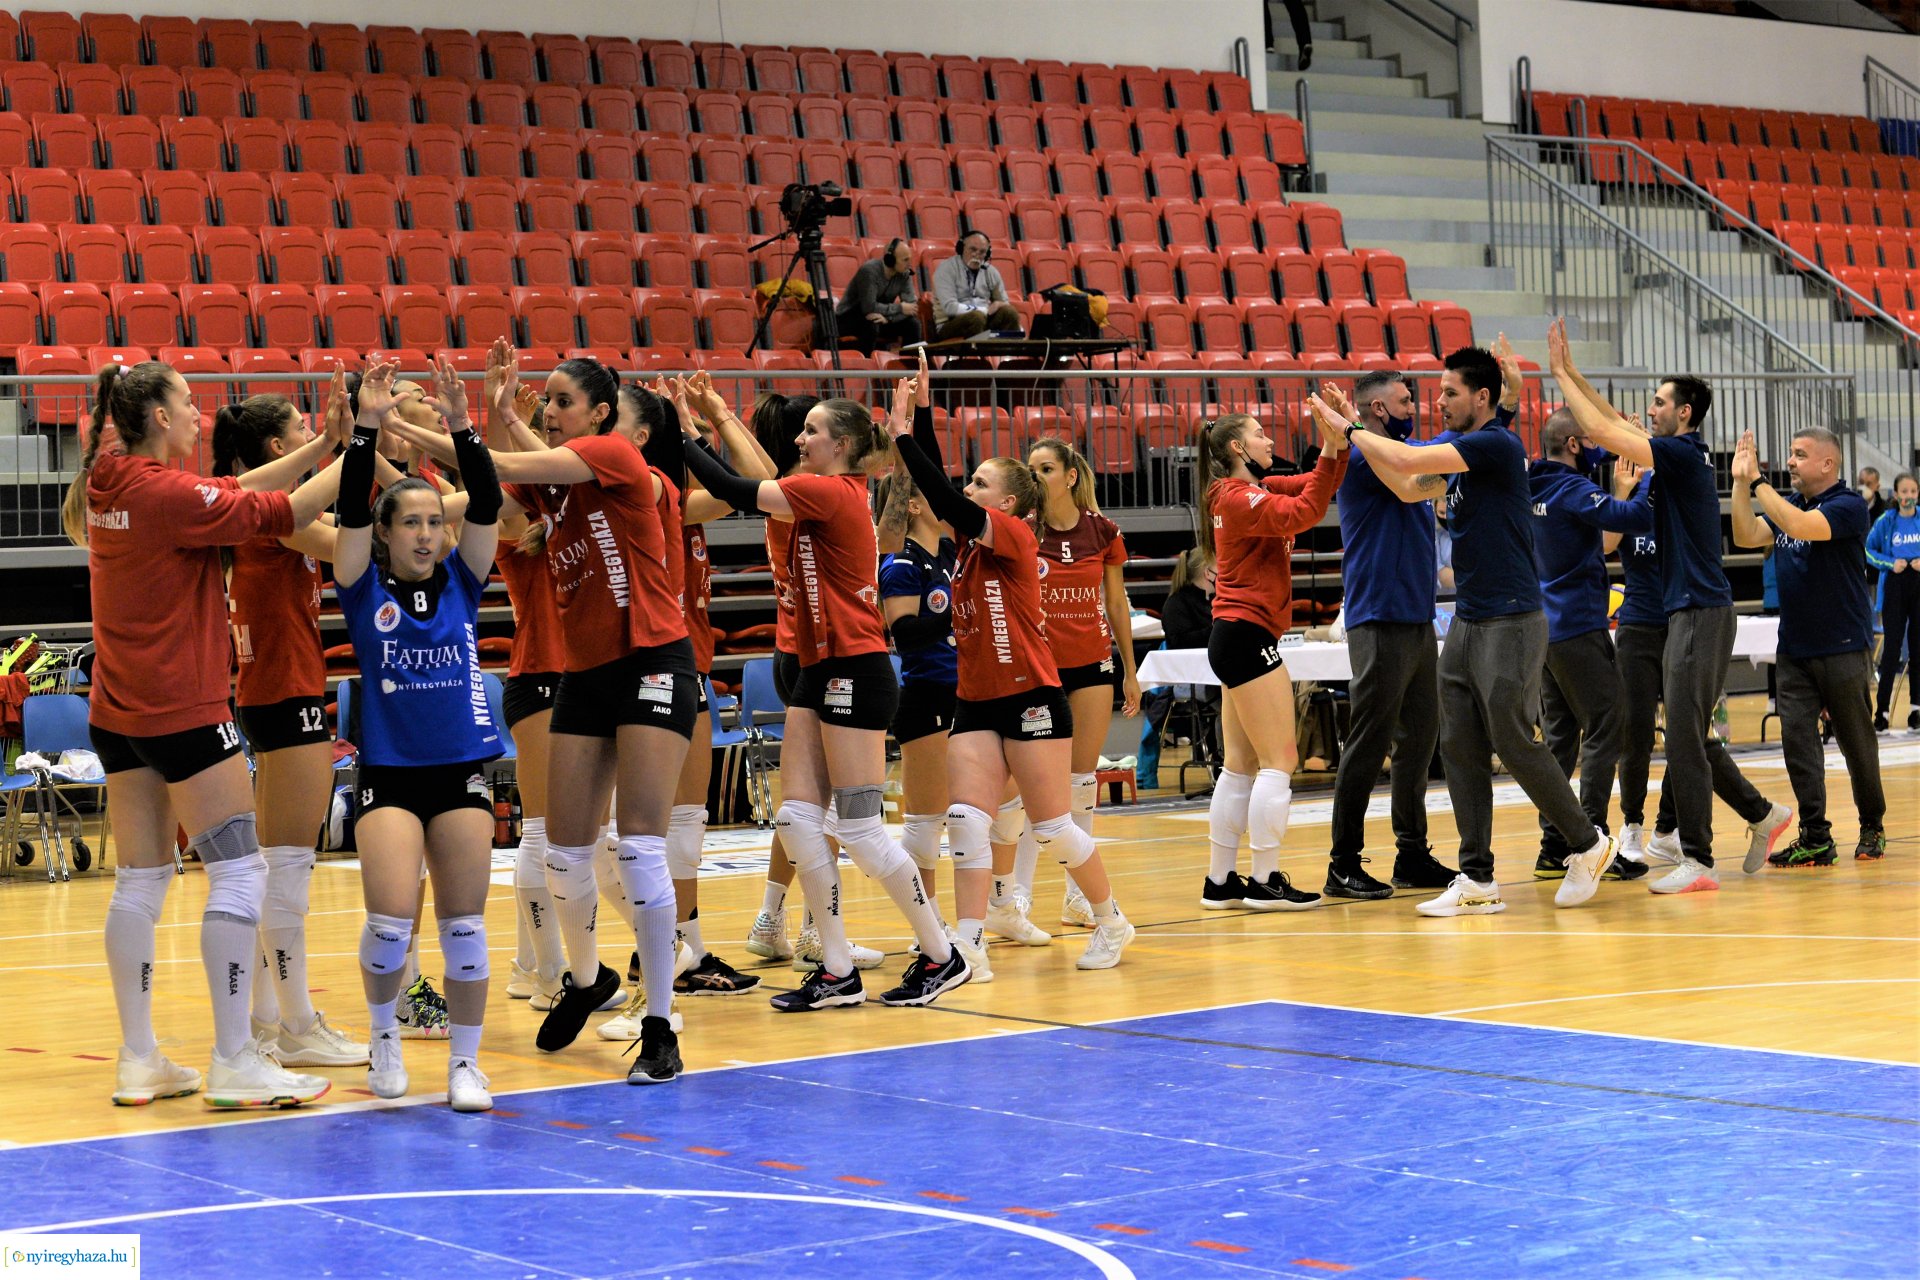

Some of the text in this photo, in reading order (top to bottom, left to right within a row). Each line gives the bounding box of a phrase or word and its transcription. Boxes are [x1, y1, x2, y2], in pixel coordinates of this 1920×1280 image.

[1061, 541, 1072, 559] 5
[1902, 533, 1920, 544] JAK
[413, 590, 428, 613] 8
[984, 580, 1013, 664] NYÍREGYHÁZA
[381, 638, 462, 666] FATUM
[1260, 646, 1279, 666] 15
[398, 679, 464, 691] NYÍREGYHÁZA
[464, 622, 492, 726] NYÍREGYHÁZA
[299, 706, 323, 732] 12
[652, 705, 672, 715] JAKO
[832, 707, 852, 715] JAKO
[216, 721, 240, 751] 18
[827, 883, 839, 916] MIKASA
[529, 901, 544, 929] MIKASA
[141, 962, 153, 992] MIKASA
[228, 962, 245, 996] MIKASA
[275, 949, 292, 981] MIKASA
